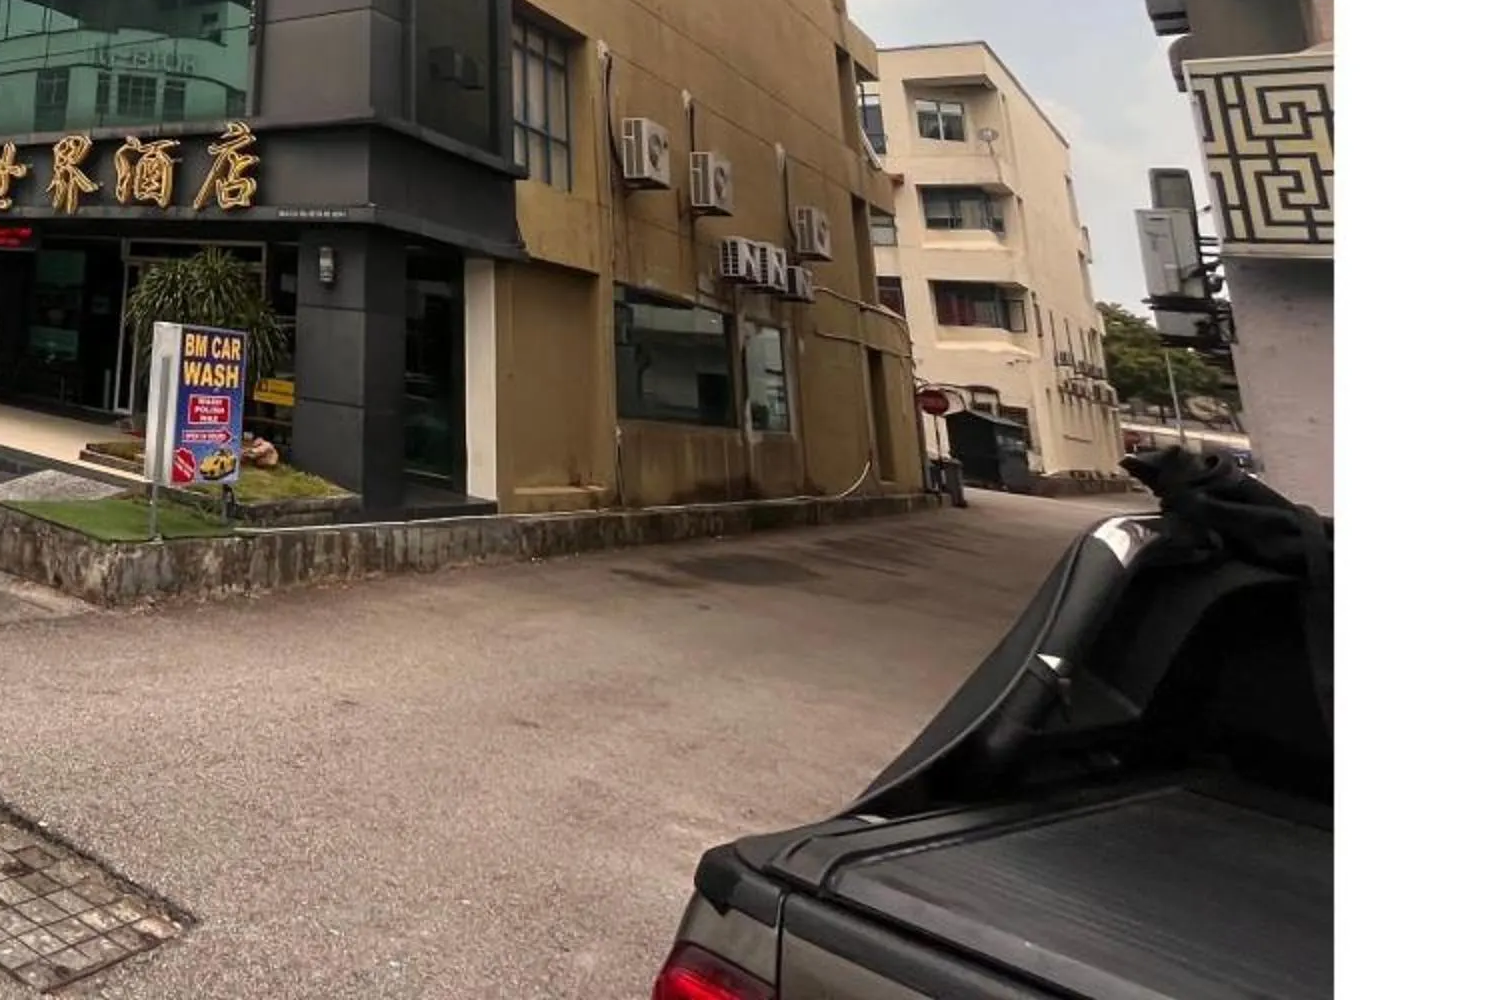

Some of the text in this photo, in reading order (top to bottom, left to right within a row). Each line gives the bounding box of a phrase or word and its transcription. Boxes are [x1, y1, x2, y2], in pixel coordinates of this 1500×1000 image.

[184, 333, 242, 361] BM CAR
[183, 361, 240, 389] WASH
